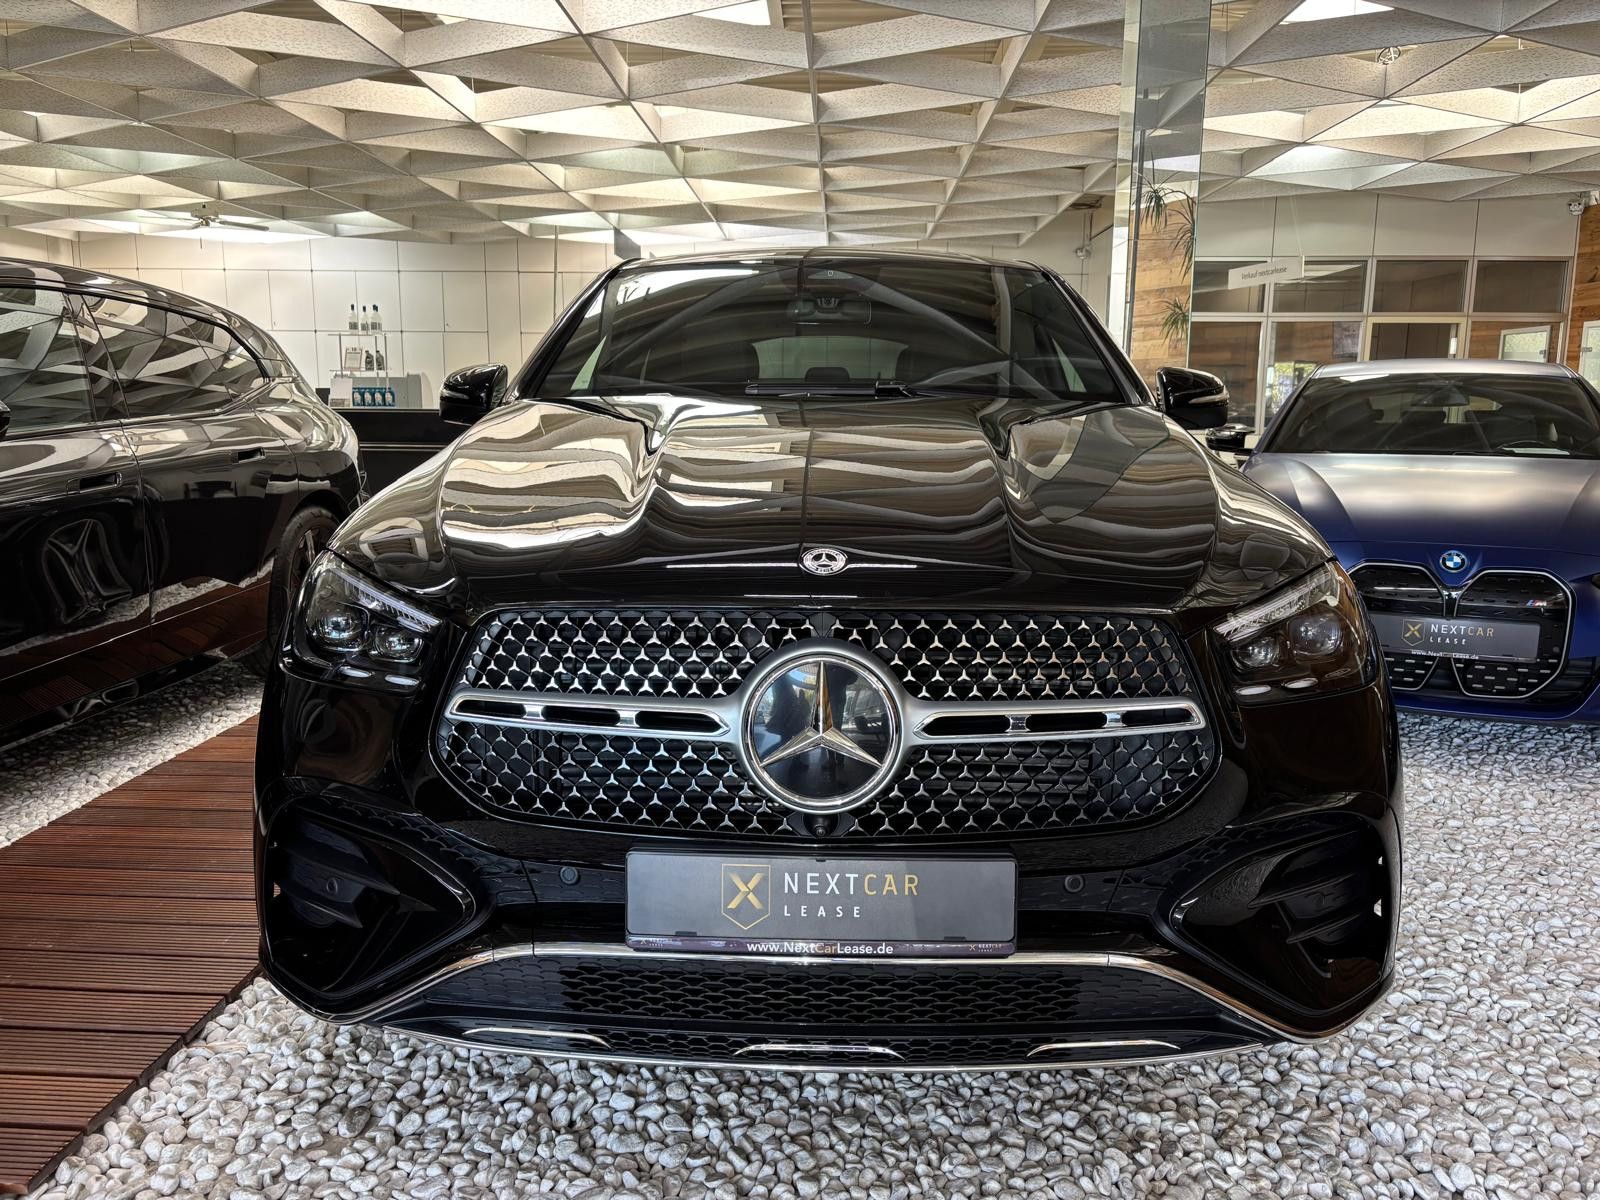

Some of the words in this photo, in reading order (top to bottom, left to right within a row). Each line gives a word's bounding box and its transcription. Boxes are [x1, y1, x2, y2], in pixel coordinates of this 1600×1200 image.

[1431, 624, 1494, 637] NEXTCAR
[1429, 636, 1466, 645] LEASE
[784, 872, 919, 896] NEXTCAR
[784, 905, 860, 918] LEASE
[746, 941, 894, 954] www.NextCarLease.de
